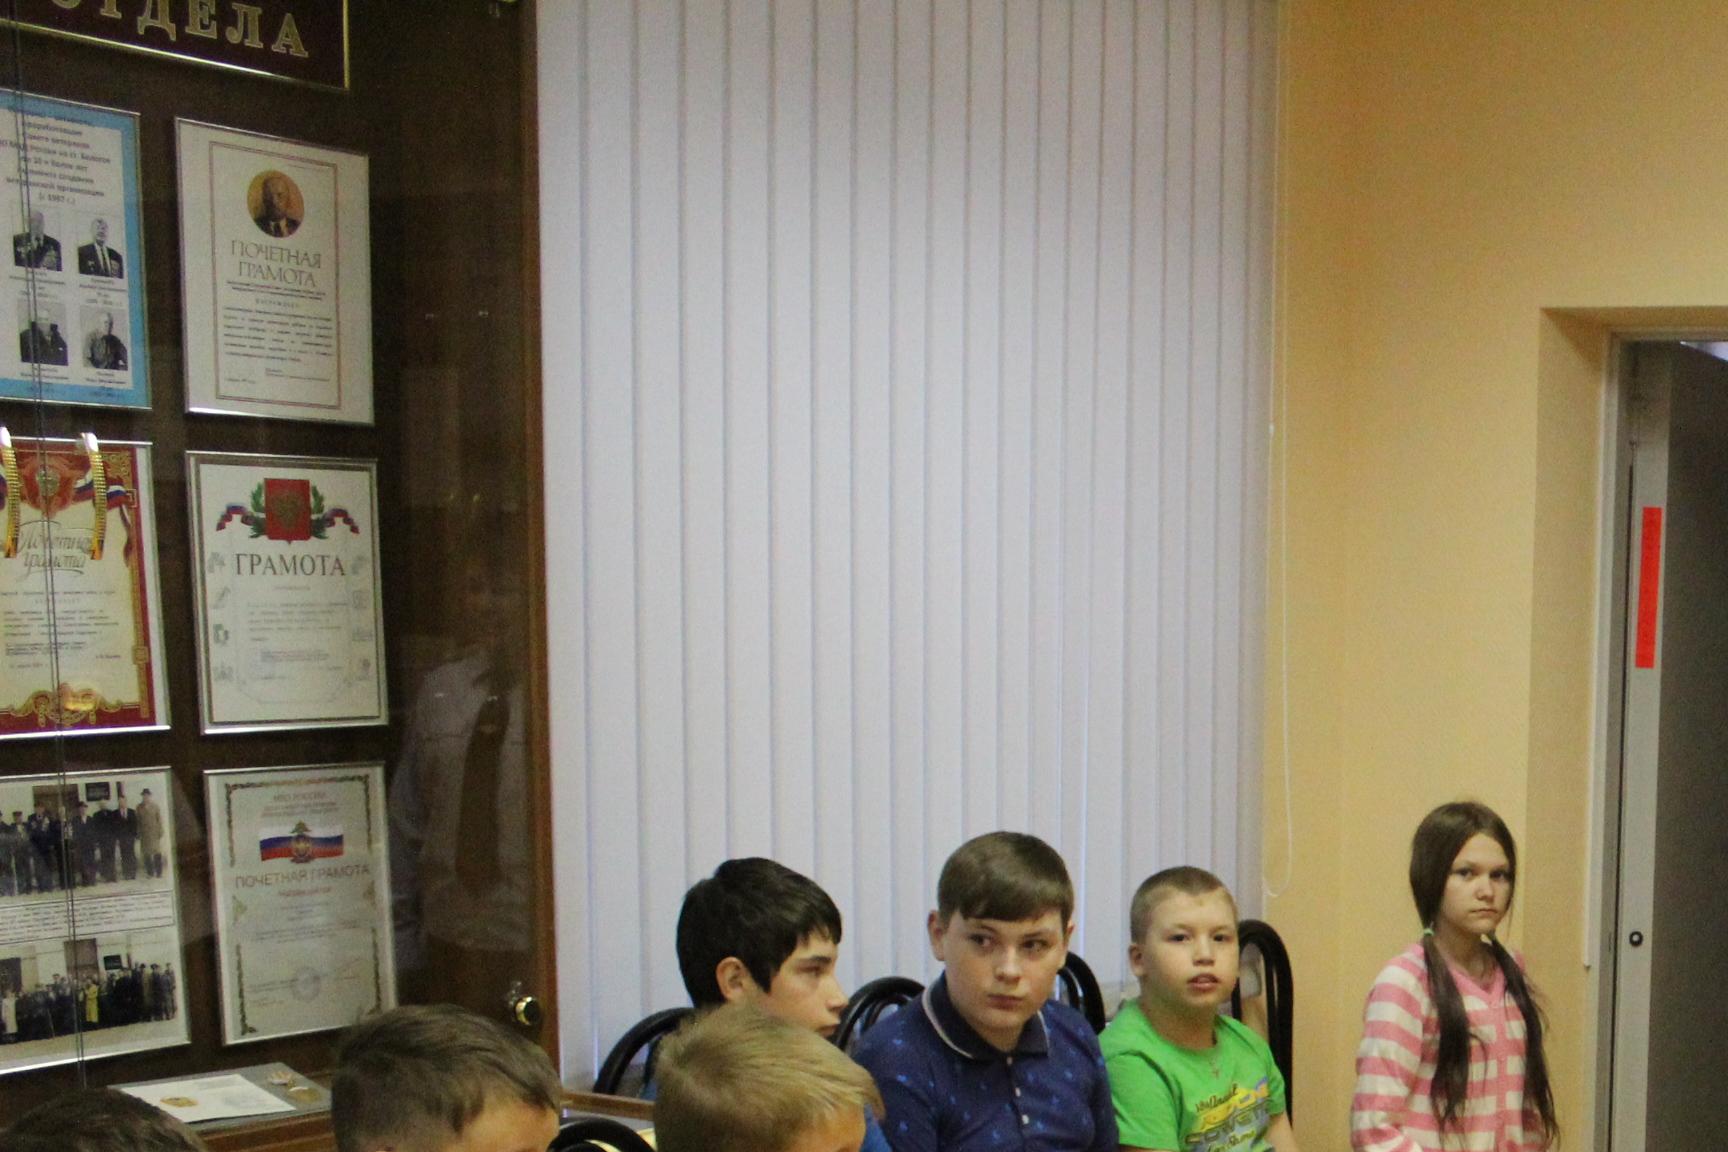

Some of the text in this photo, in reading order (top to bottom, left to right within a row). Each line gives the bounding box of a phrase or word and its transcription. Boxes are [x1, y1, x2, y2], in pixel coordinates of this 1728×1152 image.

[53, 0, 309, 58] ДЕЛА
[231, 240, 322, 269] ПОЧЕТНАЯ
[239, 261, 316, 288] ГРАМОТА
[235, 553, 346, 576] ГРАМОТА
